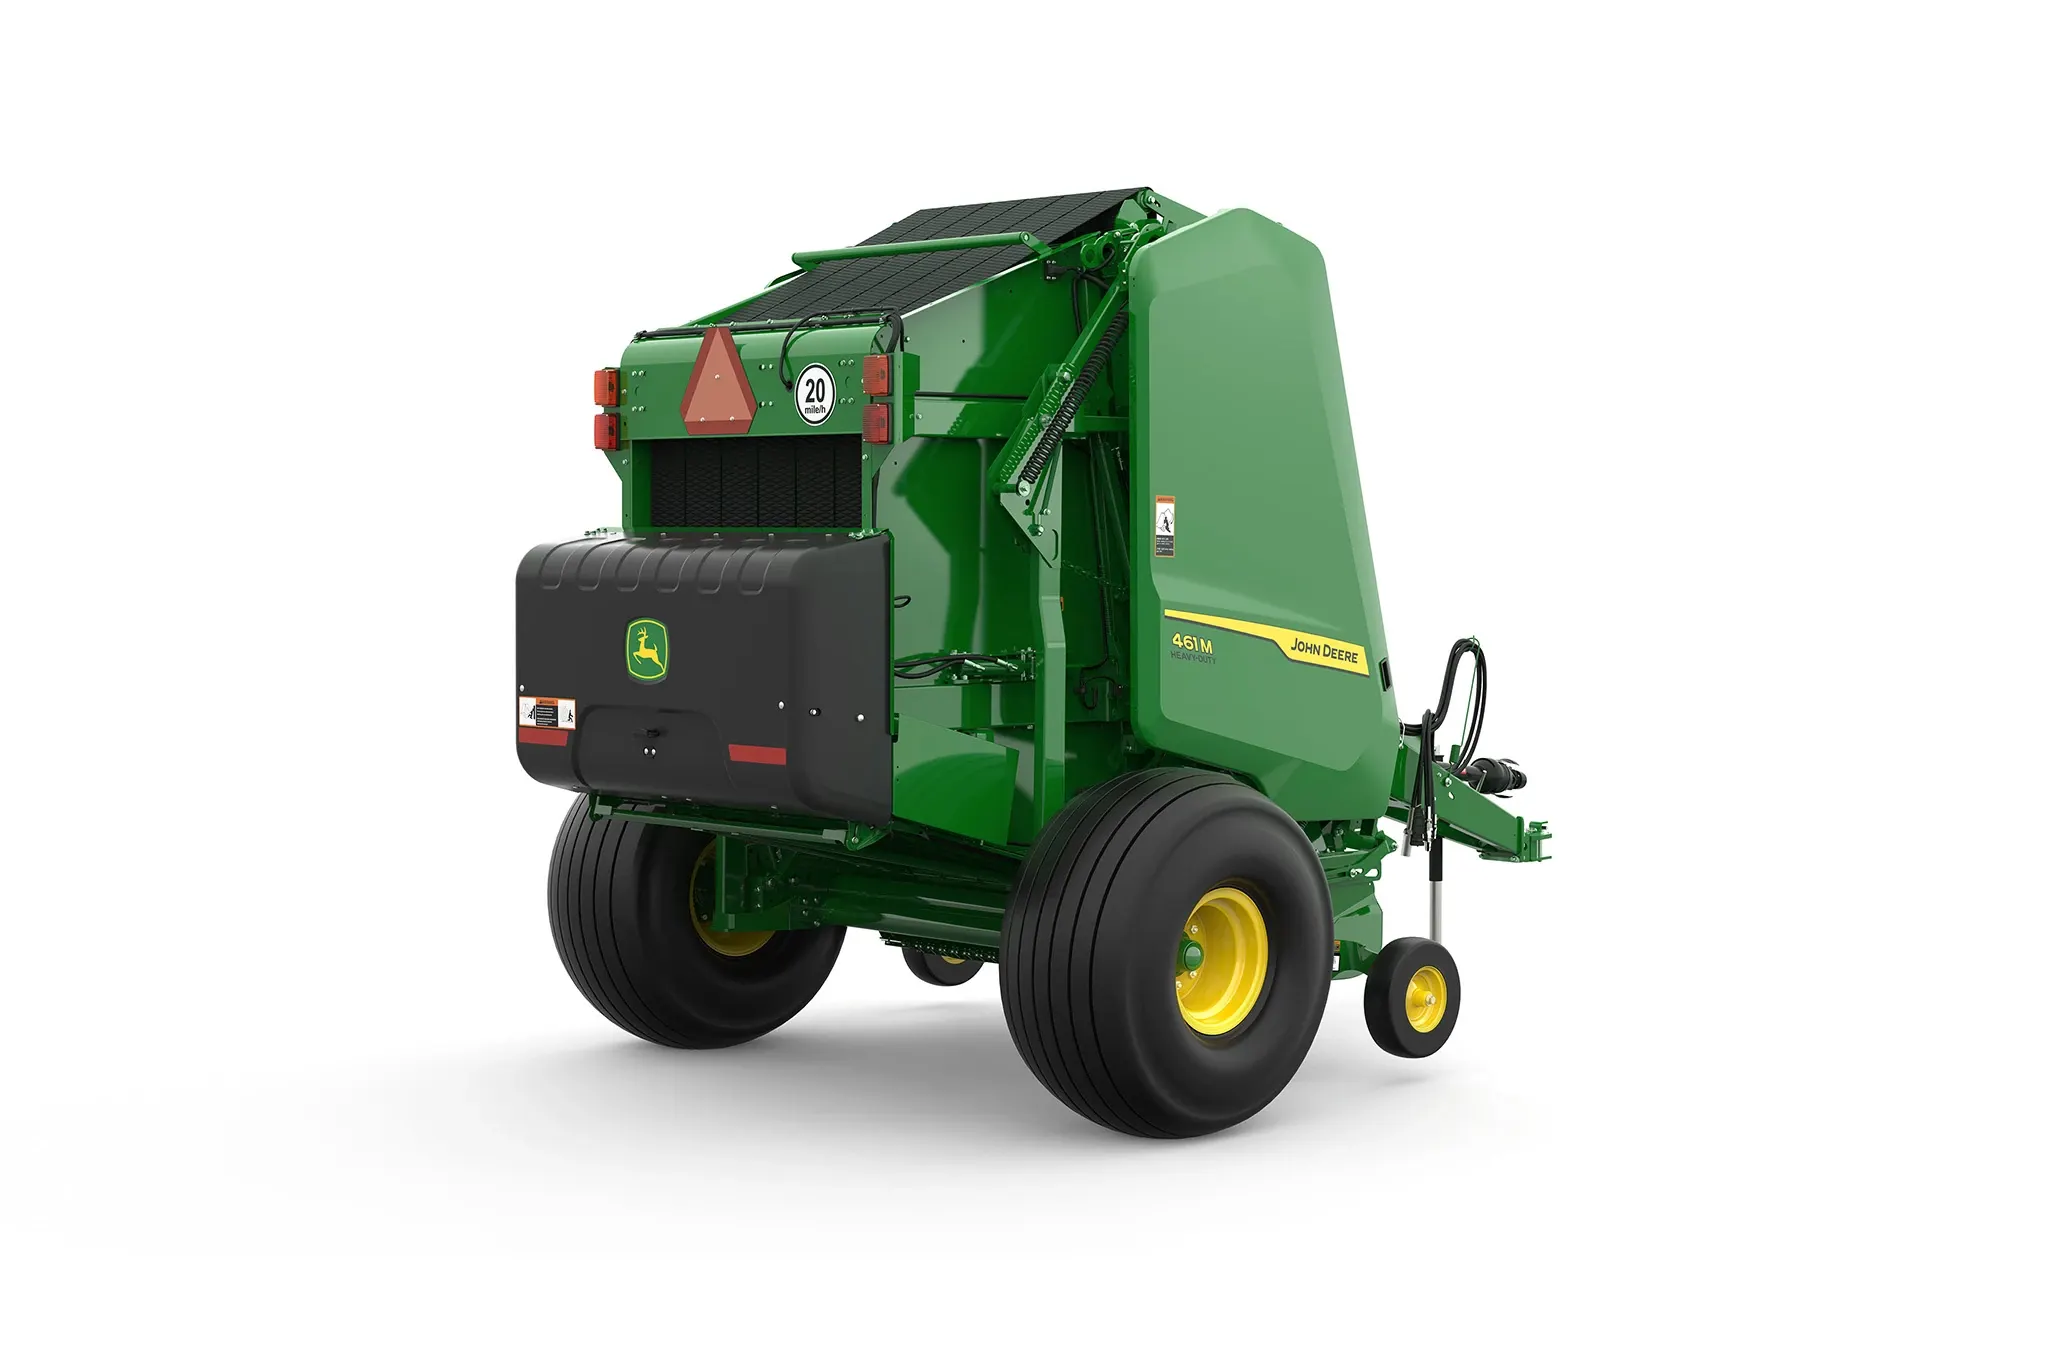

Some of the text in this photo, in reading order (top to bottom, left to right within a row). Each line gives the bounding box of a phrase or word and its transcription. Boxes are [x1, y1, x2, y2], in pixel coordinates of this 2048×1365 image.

[805, 378, 825, 403] 20
[805, 405, 826, 414] mile/h
[1291, 638, 1359, 664] JOHN DEERE
